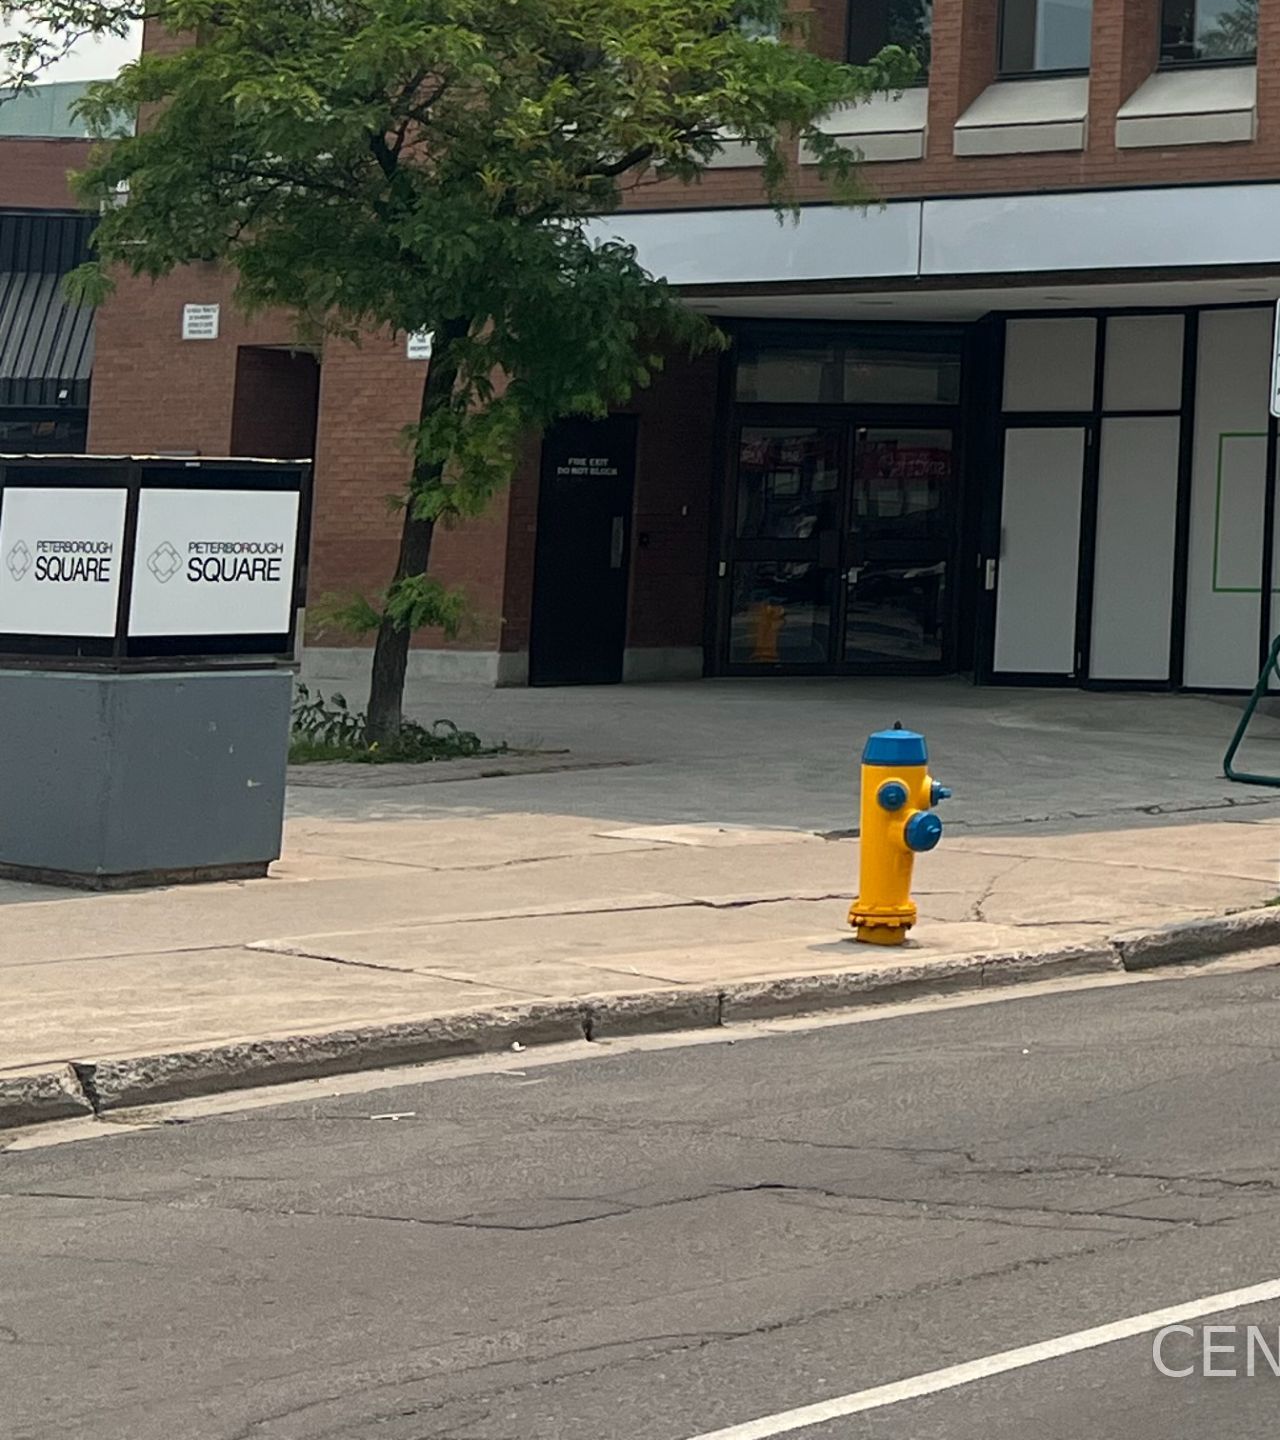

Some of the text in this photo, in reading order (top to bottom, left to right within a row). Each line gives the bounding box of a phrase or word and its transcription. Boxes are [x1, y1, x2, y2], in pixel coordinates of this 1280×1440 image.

[36, 540, 113, 553] PETERBOROUGH
[188, 542, 284, 555] PETERBOROUGH
[34, 556, 112, 582] SQUARE
[186, 557, 282, 583] SQUARE
